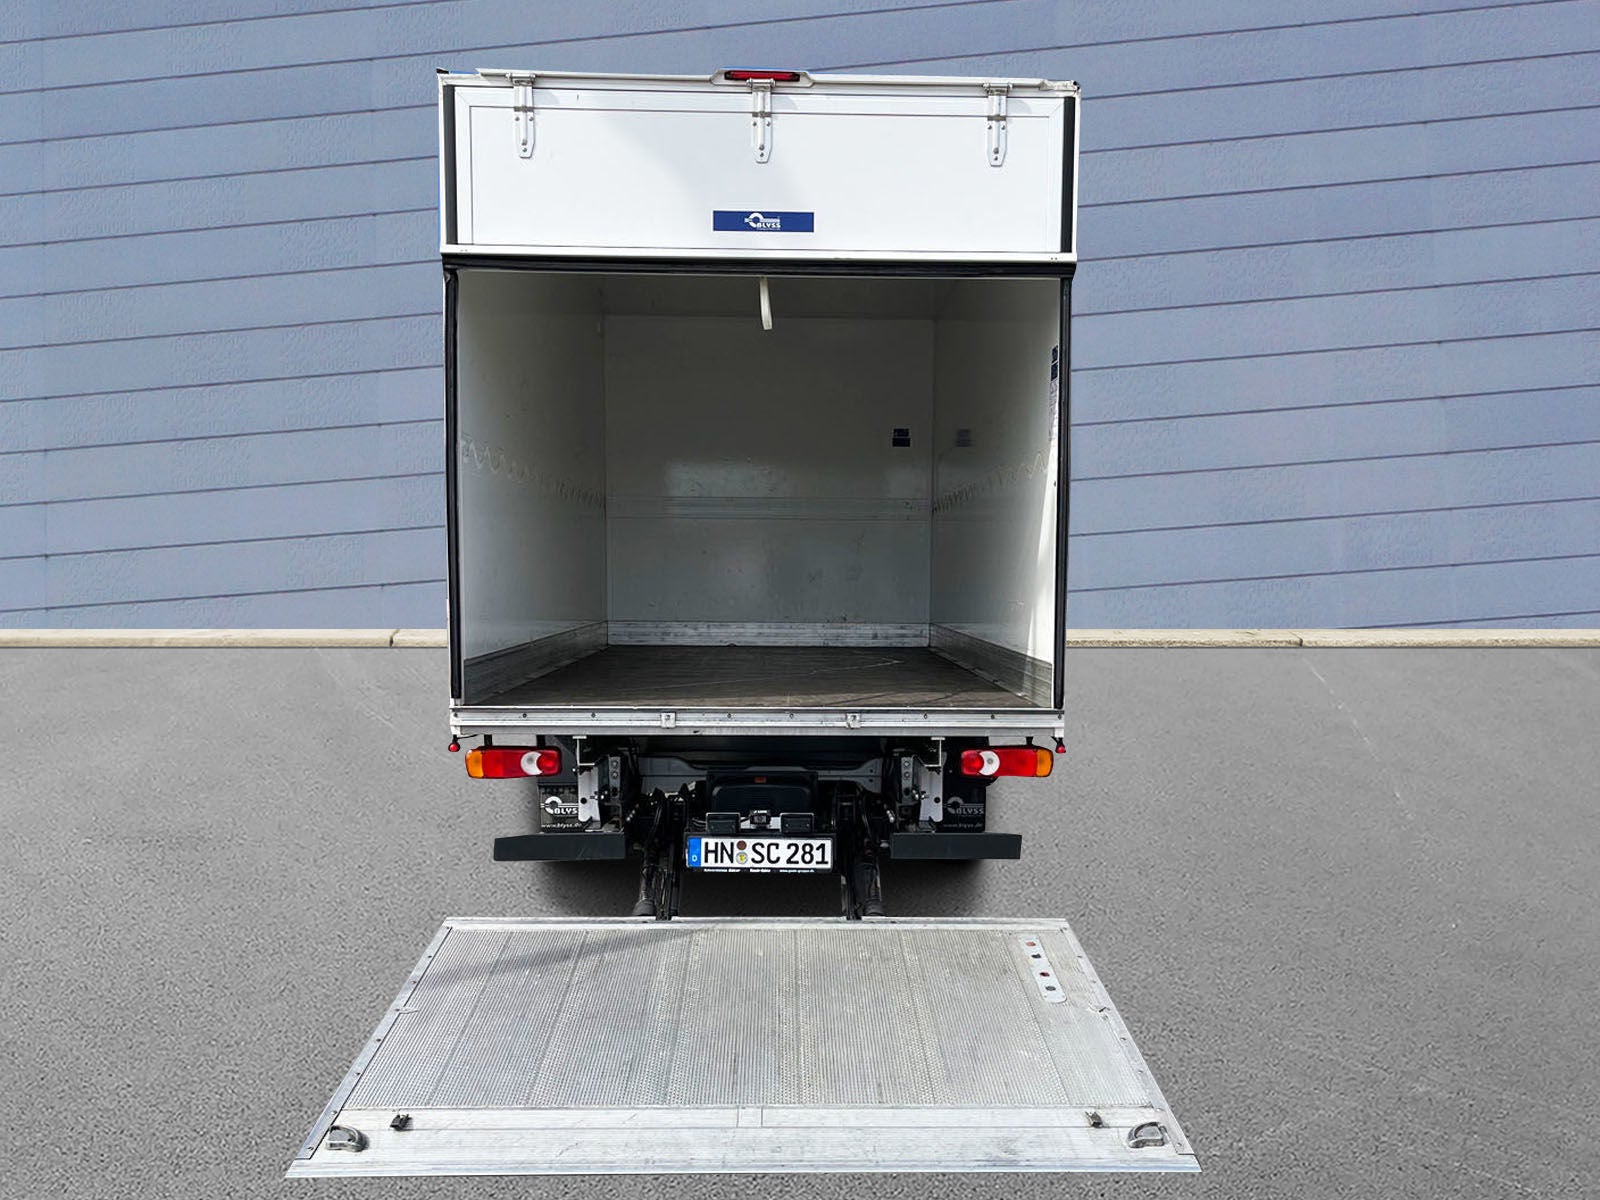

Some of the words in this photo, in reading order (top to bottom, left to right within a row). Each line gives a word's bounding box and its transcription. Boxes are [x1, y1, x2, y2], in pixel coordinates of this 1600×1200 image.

[704, 841, 734, 863] HN
[750, 842, 781, 865] SC
[786, 842, 829, 865] 281
